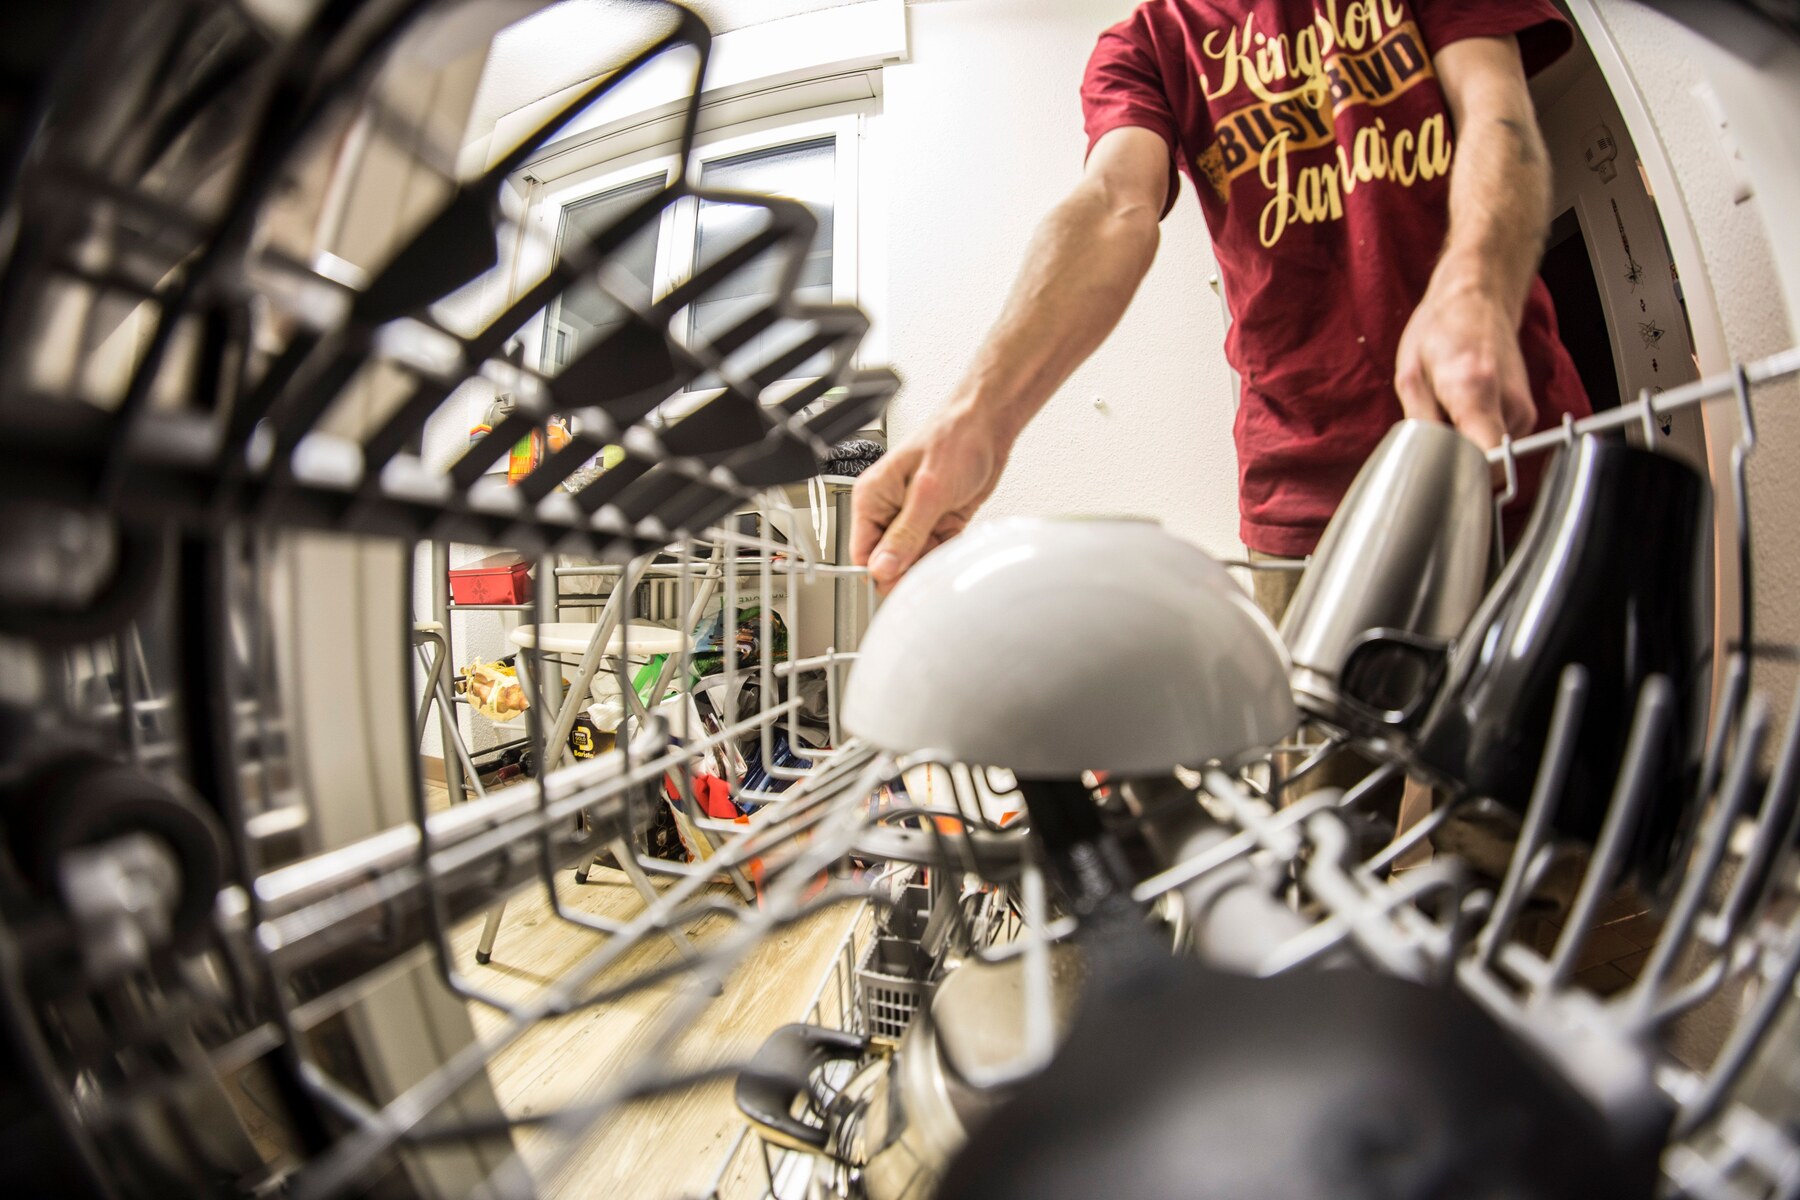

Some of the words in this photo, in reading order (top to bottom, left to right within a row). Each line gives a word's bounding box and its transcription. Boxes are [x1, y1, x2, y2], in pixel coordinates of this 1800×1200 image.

[1200, 0, 1404, 109] Kingston
[1216, 98, 1330, 173] BUSY
[1326, 32, 1426, 106] BLVD
[1259, 113, 1452, 248] Jamaica
